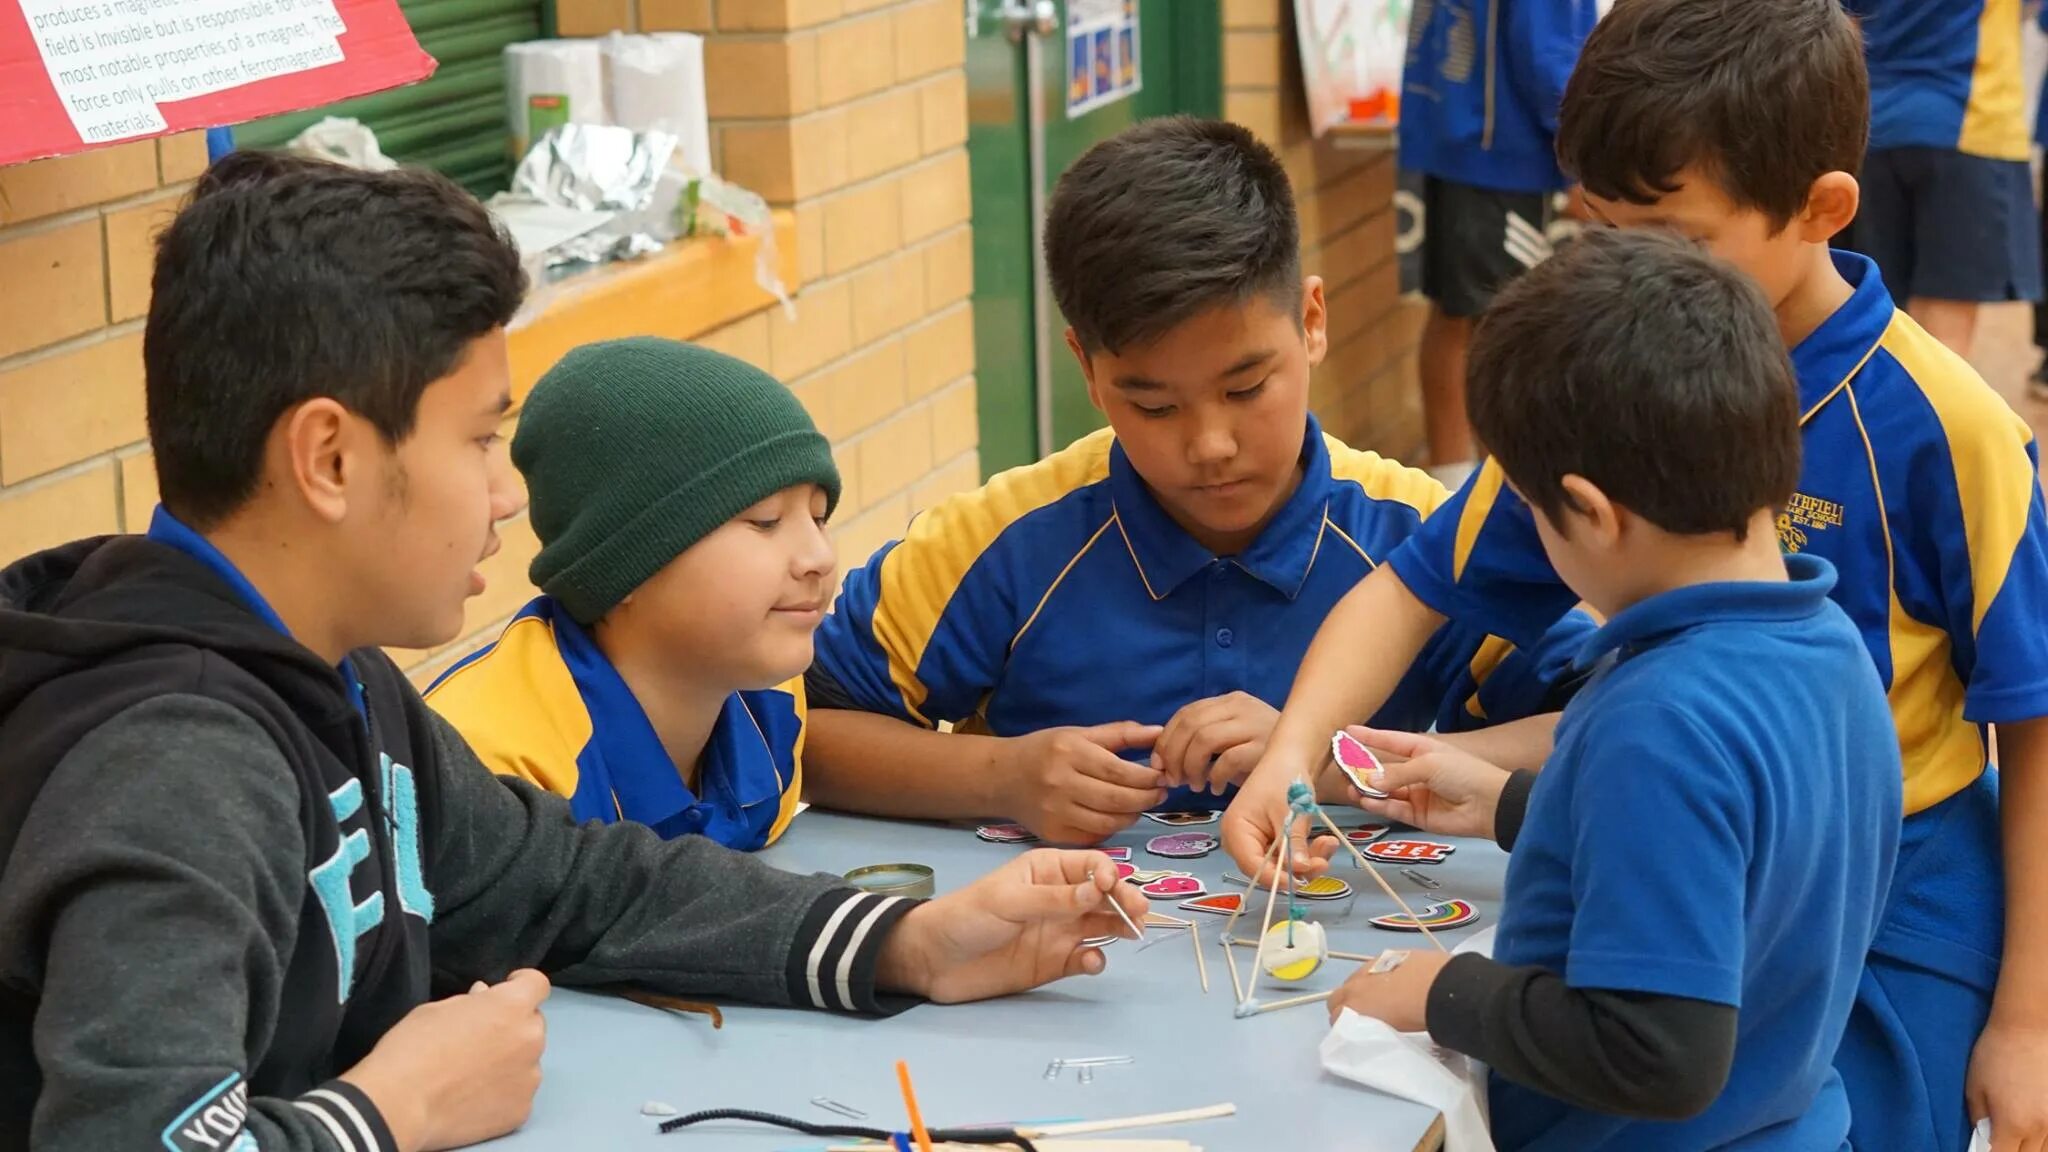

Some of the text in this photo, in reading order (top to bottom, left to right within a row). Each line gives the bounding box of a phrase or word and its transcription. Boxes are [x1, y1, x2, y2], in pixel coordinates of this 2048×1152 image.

[33, 5, 101, 32] produces
[103, 2, 112, 17] a
[45, 34, 79, 57] field
[81, 32, 95, 50] is
[154, 18, 181, 37] but
[182, 16, 194, 31] is
[195, 0, 274, 28] responsible
[59, 64, 97, 86] most
[99, 53, 153, 76] notable
[154, 41, 227, 69] properties
[228, 33, 241, 52] of
[245, 35, 255, 48] a
[312, 14, 343, 33] The
[71, 44, 339, 112] force only pulls on other ferromagnetic
[88, 111, 160, 139] materials.
